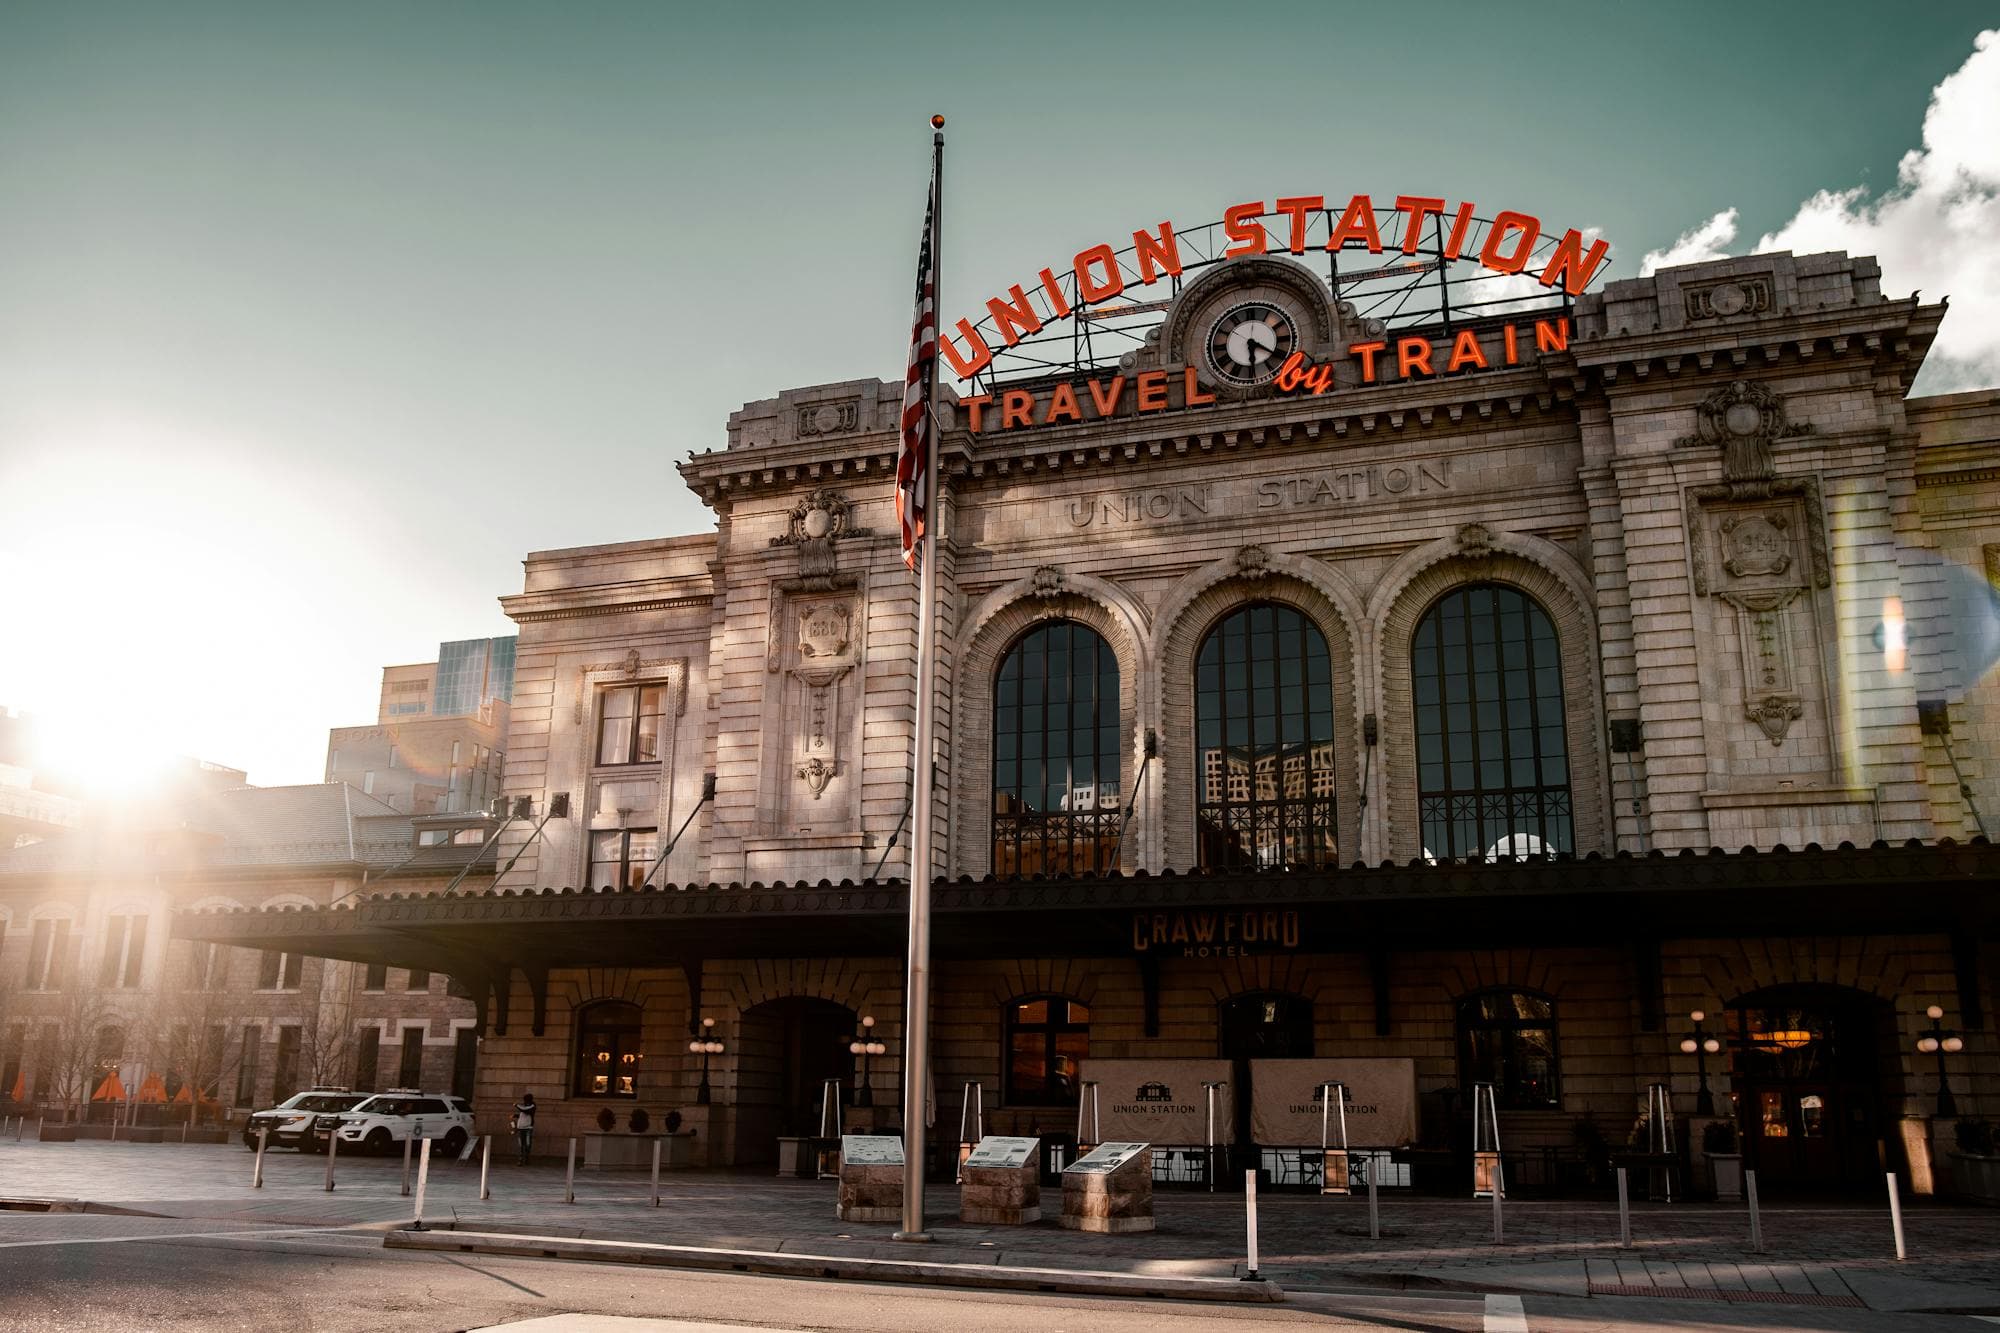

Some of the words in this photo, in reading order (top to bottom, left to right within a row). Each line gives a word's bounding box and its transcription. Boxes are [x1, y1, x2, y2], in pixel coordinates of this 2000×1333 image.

[938, 221, 1183, 380] UNION
[1224, 194, 1609, 297] STATION
[959, 365, 1216, 434] TRAVEL
[1273, 350, 1334, 395] by
[1350, 315, 1570, 383] TRAIN
[1068, 486, 1210, 528] UNION
[1257, 458, 1451, 509] STATION
[1132, 910, 1299, 951] CRAWFORD
[1183, 944, 1249, 959] HOTEL
[1112, 1104, 1147, 1114] UNION
[1150, 1104, 1196, 1114] STATION
[1288, 1104, 1325, 1114] UNION
